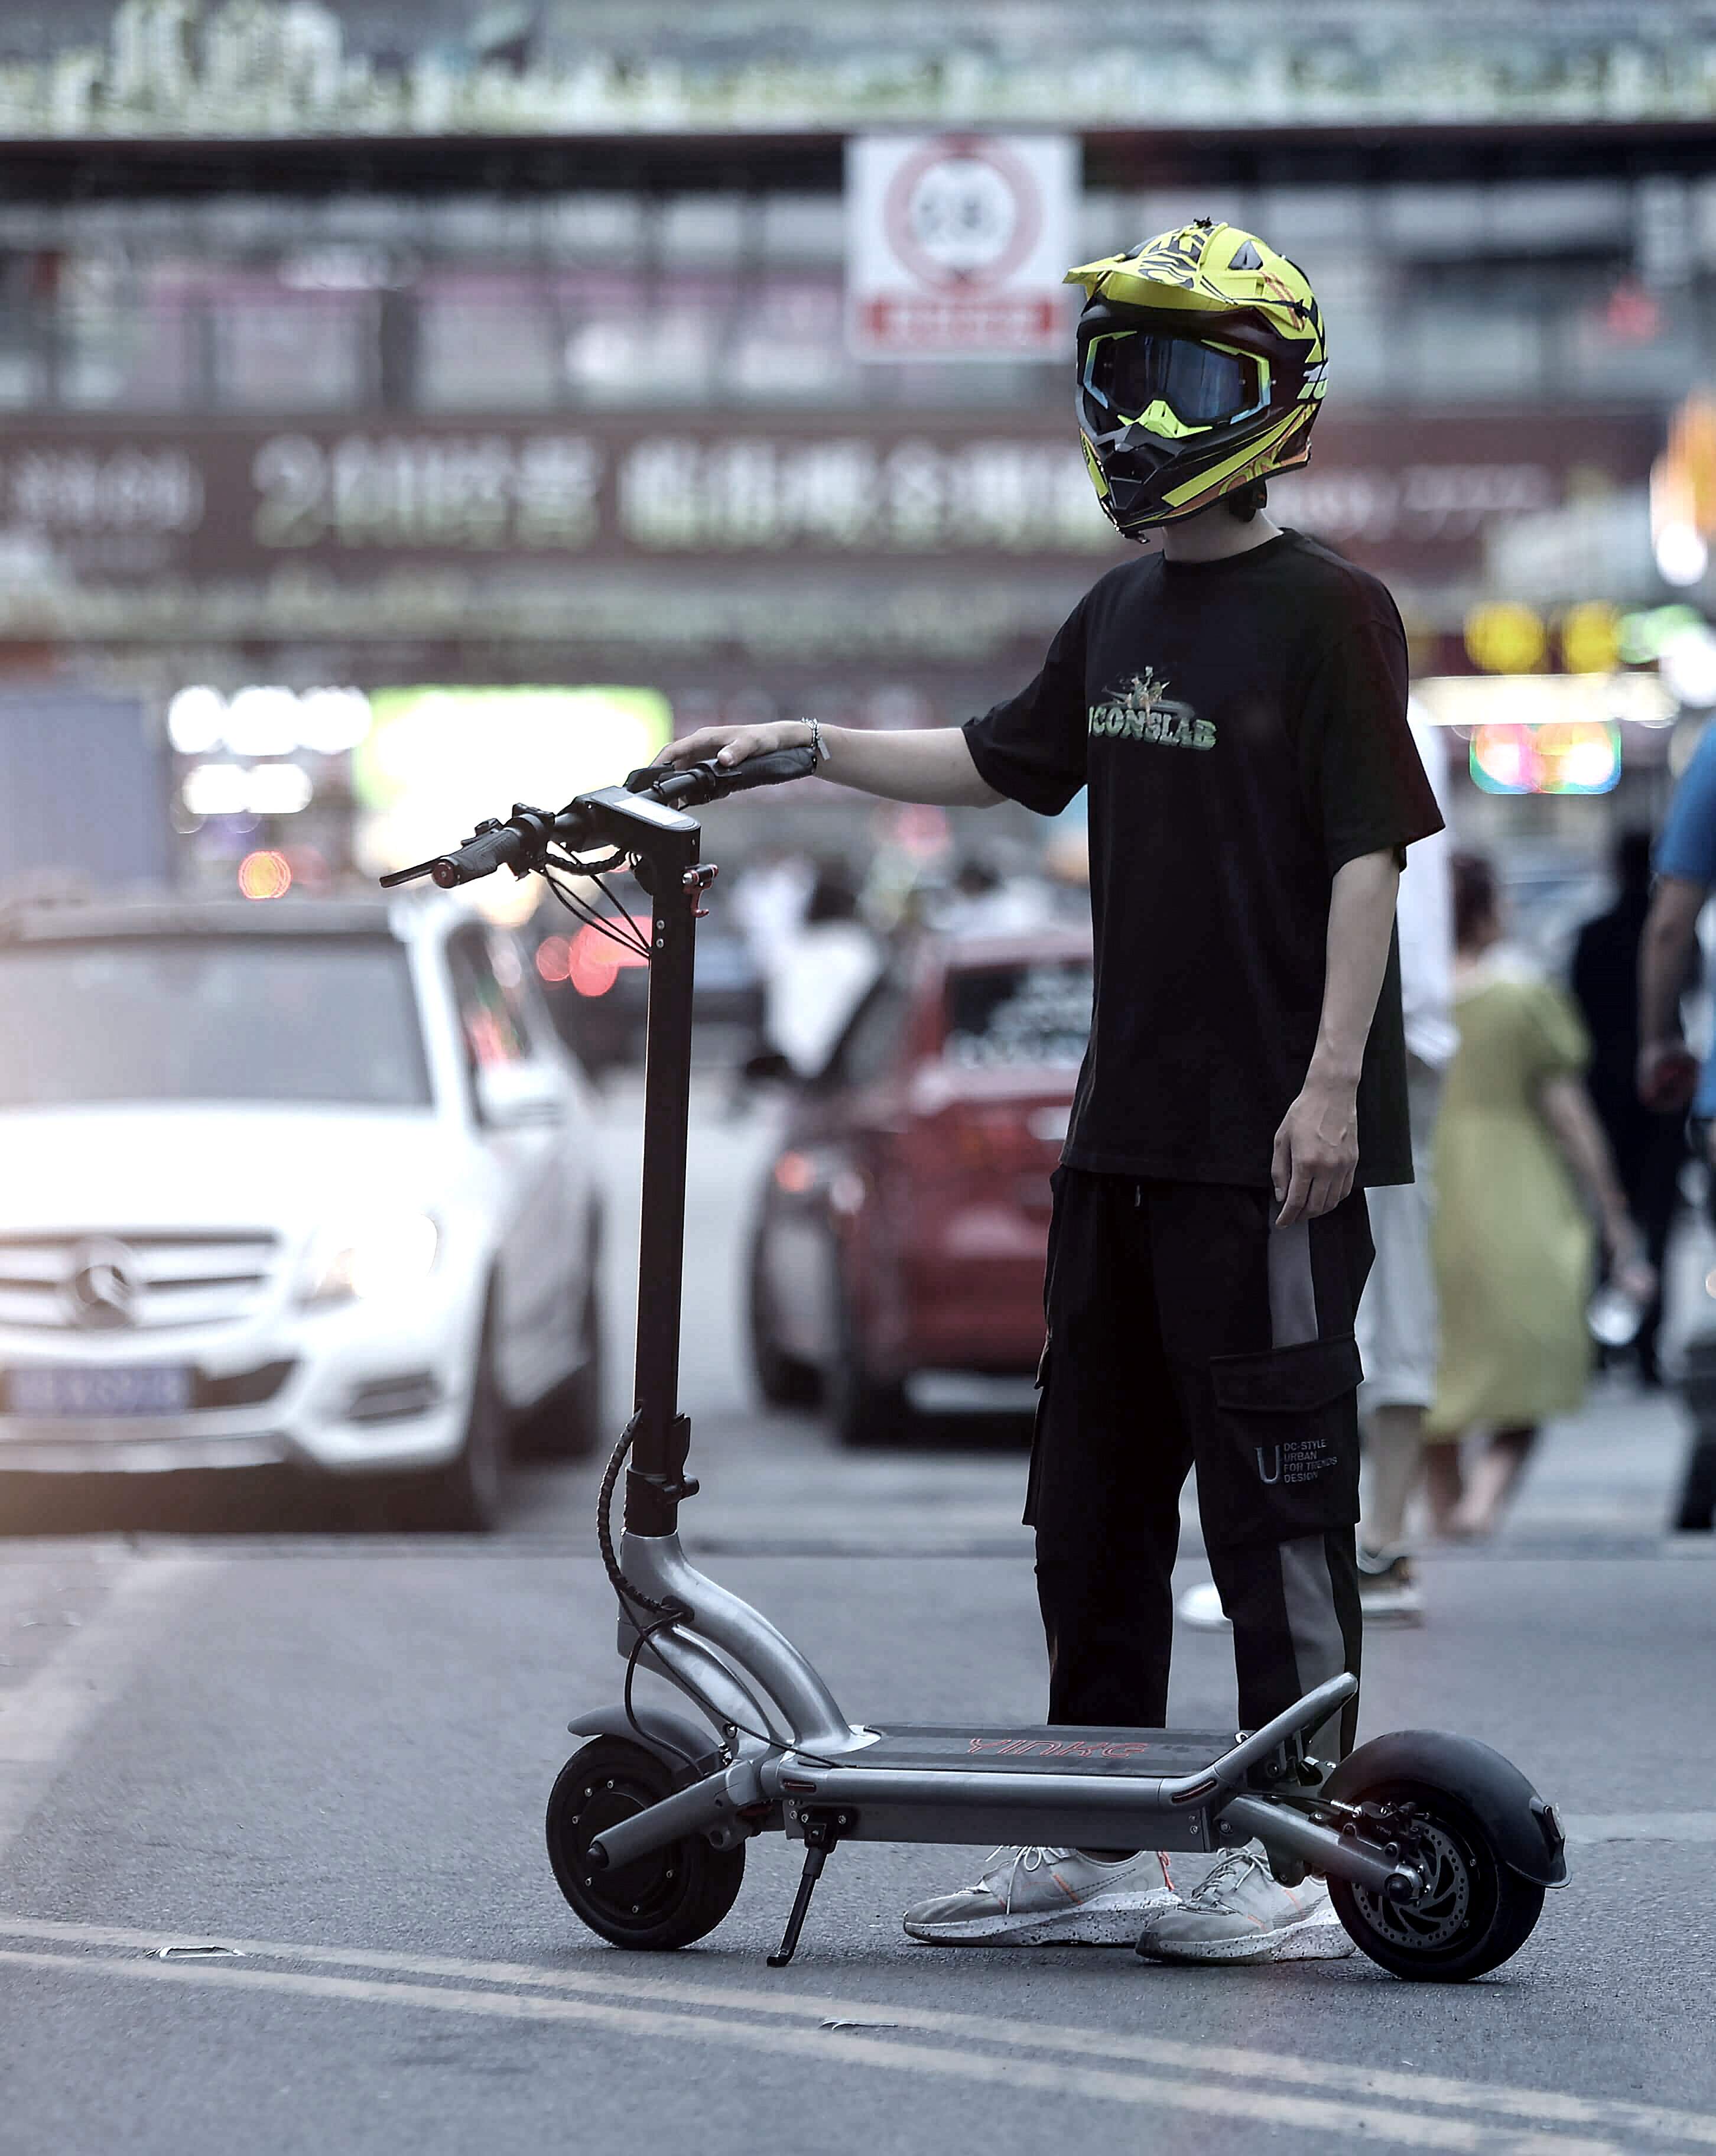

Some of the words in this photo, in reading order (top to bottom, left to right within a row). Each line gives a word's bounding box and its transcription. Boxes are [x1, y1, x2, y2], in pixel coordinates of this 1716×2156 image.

[1284, 1439, 1327, 1451] DC-STYLE
[1284, 1452, 1317, 1462] URBAN
[1254, 1445, 1280, 1484] U
[1284, 1463, 1304, 1472] FOR
